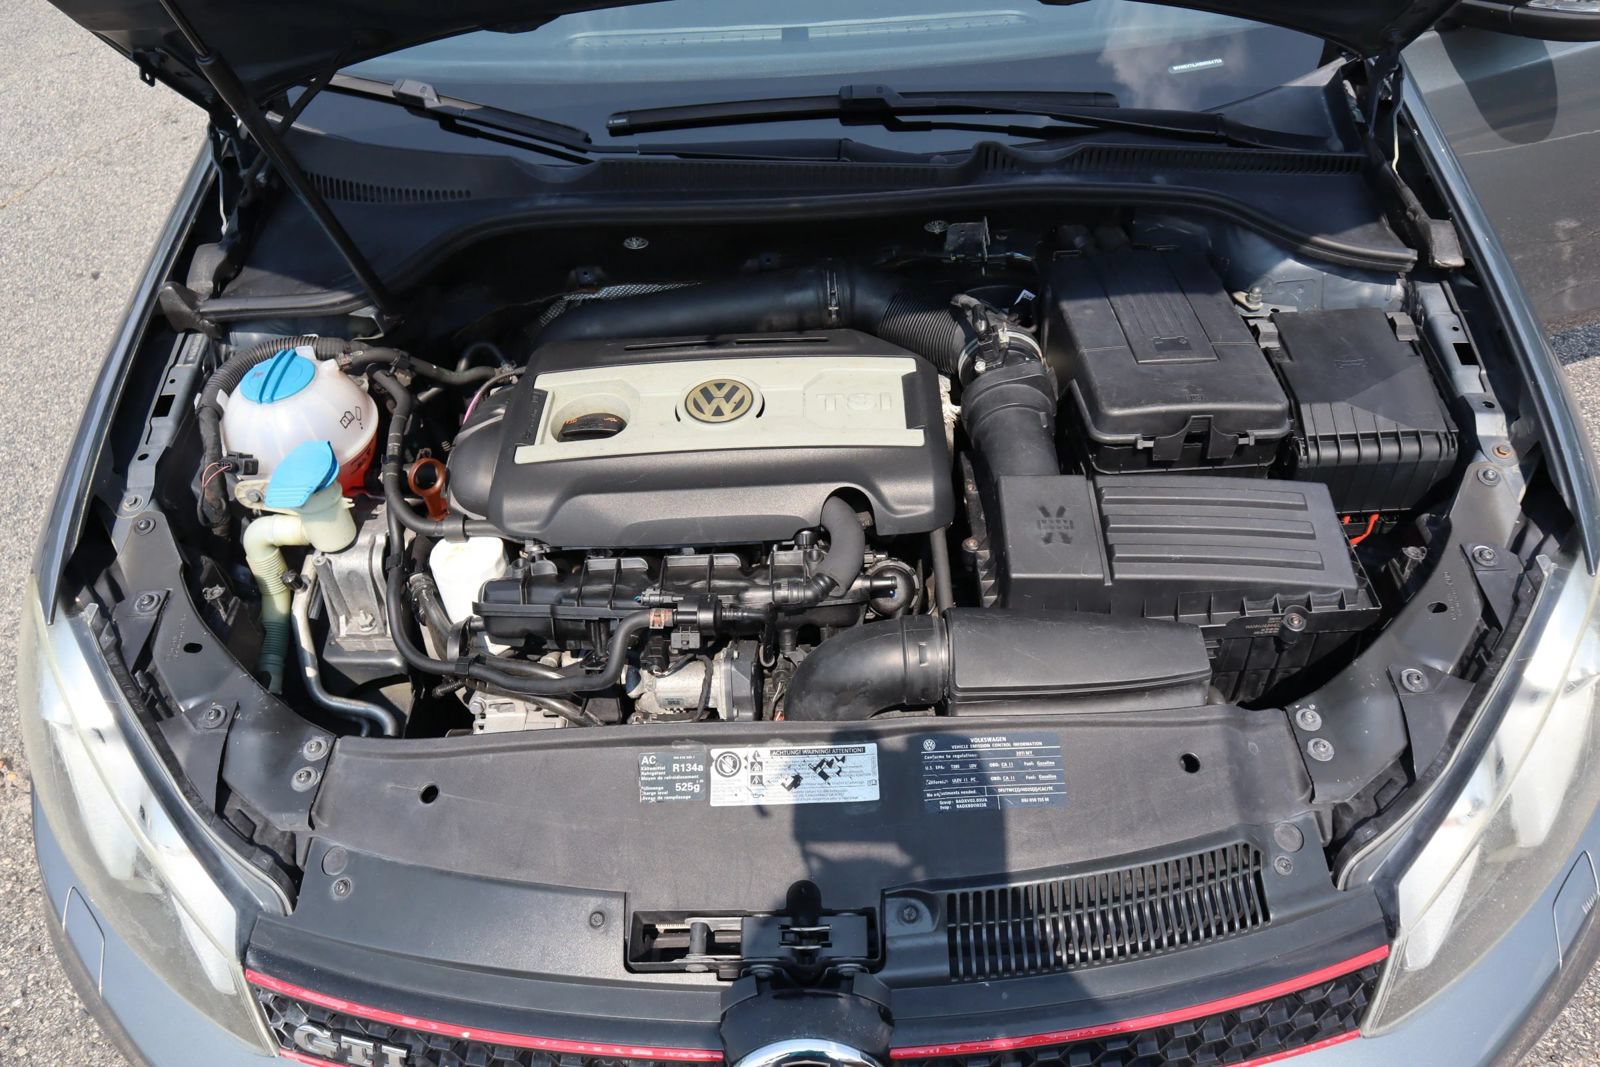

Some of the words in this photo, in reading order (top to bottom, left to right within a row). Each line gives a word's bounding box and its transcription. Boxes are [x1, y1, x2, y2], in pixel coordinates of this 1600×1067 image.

[816, 392, 892, 411] TSI
[641, 755, 656, 765] AC
[672, 763, 704, 772] R134a
[676, 782, 700, 793] 525g
[293, 1023, 408, 1067] GTI
